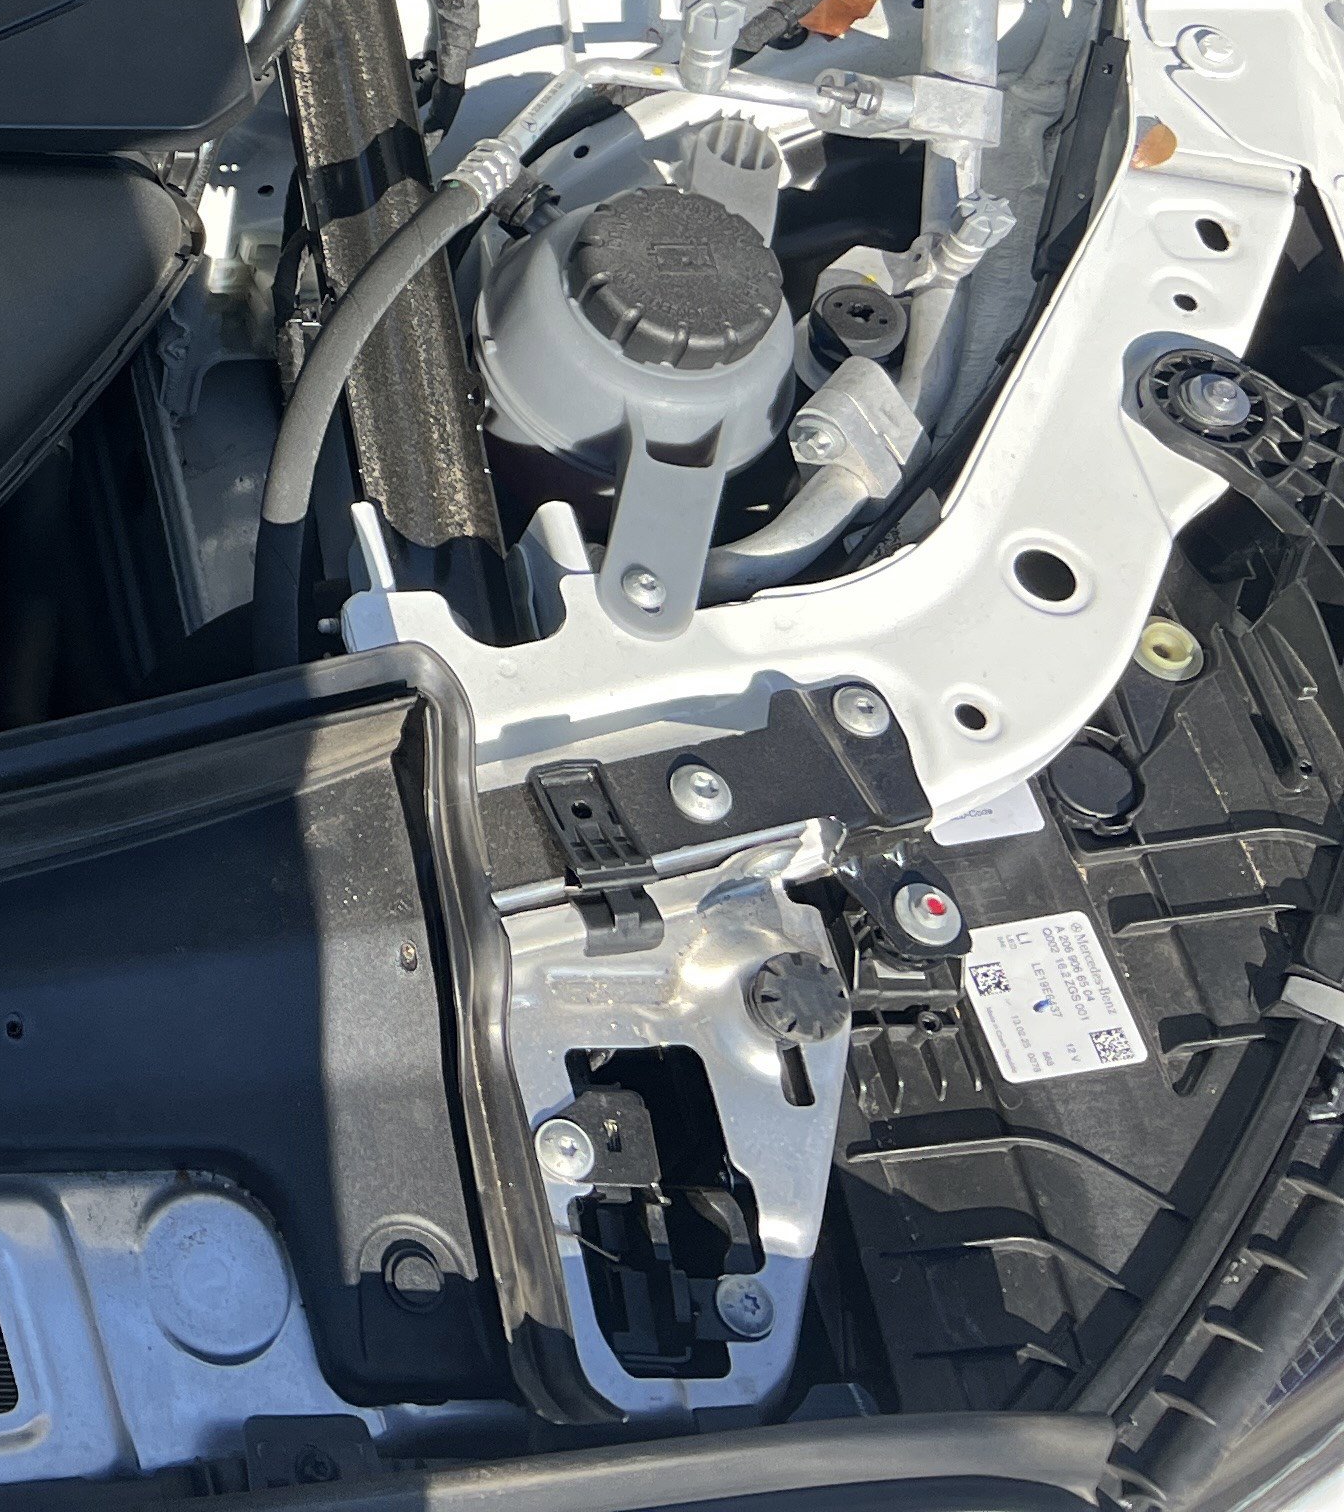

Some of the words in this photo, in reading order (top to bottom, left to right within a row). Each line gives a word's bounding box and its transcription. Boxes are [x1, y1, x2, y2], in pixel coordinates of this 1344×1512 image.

[1053, 924, 1066, 933] A
[1058, 934, 1074, 953] 206
[1076, 934, 1118, 1015] Mercedes-Benz
[1063, 978, 1082, 1002] ZGS
[1073, 1002, 1090, 1021] 001
